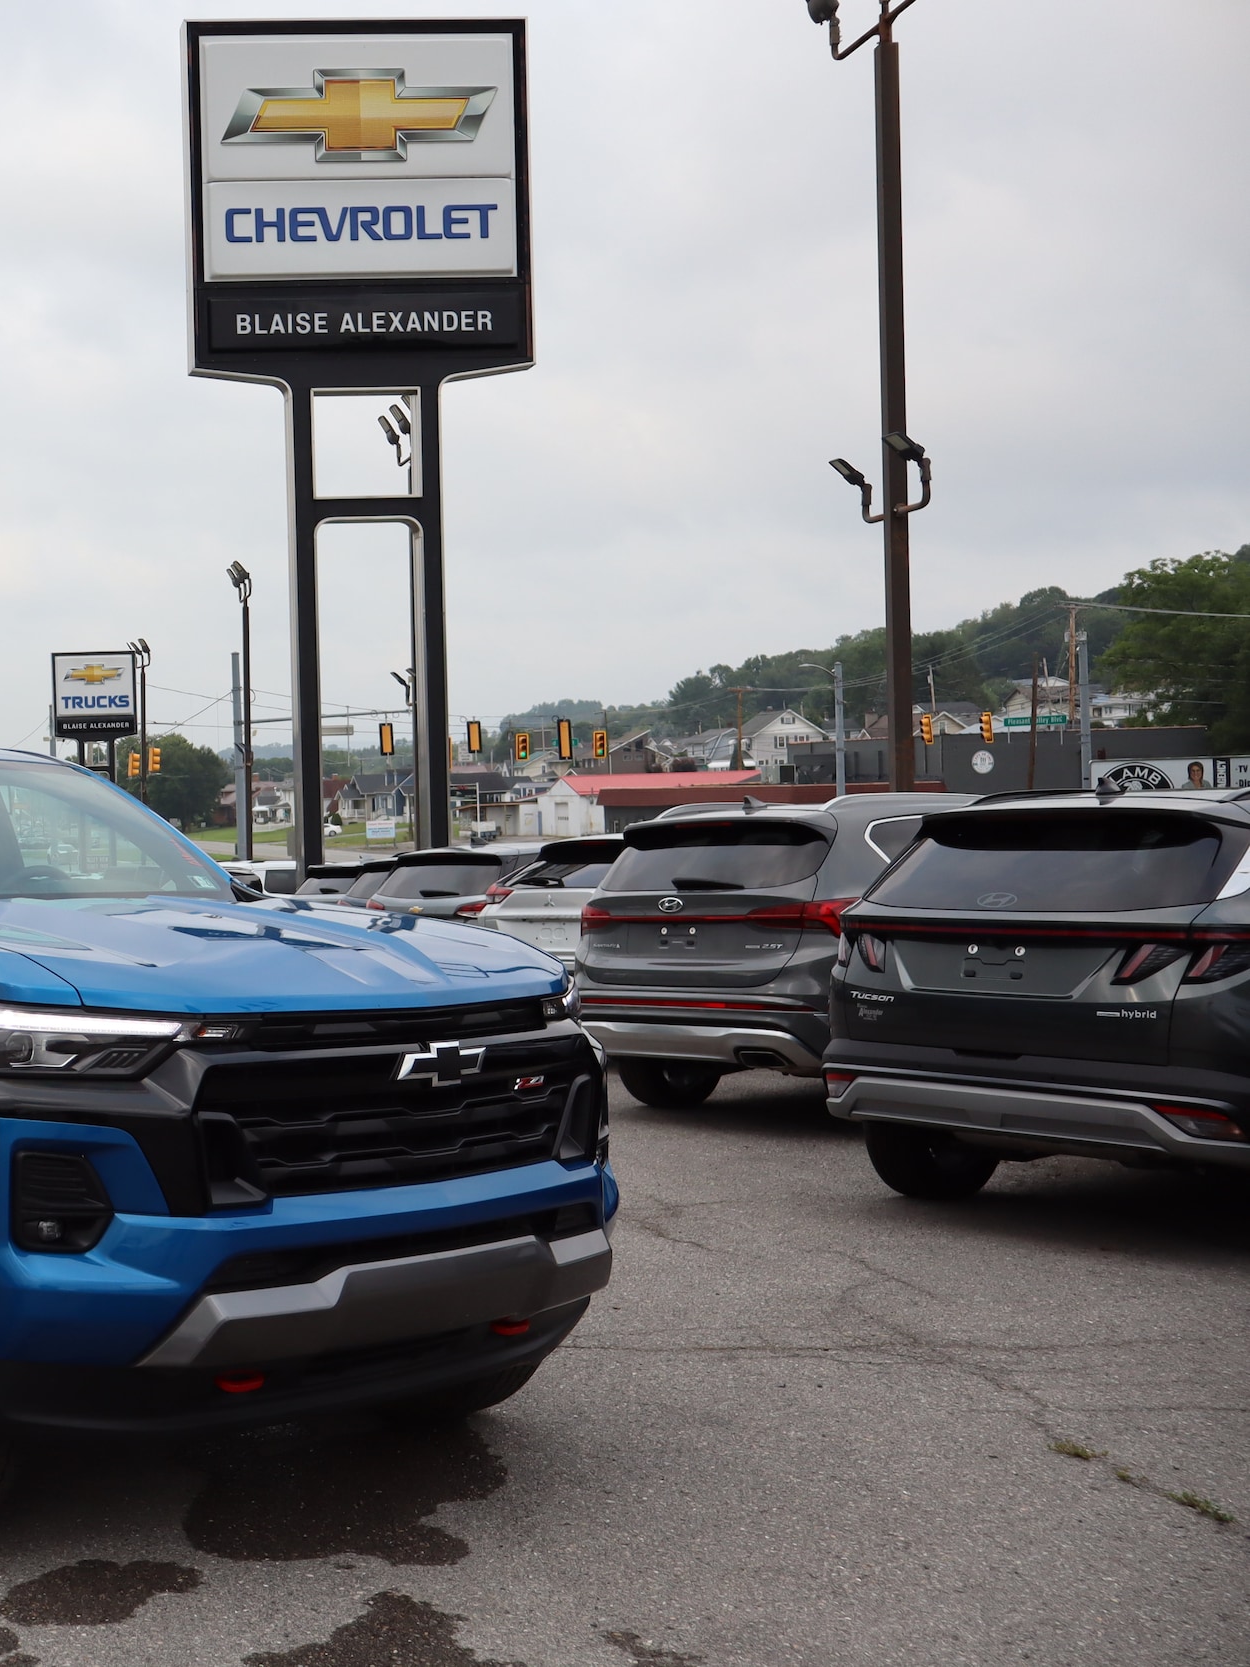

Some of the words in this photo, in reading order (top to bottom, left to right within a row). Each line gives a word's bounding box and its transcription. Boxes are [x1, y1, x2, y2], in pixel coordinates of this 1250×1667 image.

[225, 204, 498, 243] CHEVROLET
[236, 312, 329, 335] BLAISE
[340, 310, 493, 333] ALEXANDER
[61, 695, 130, 709] TRUCKS
[1109, 766, 1162, 785] LAMB
[1238, 765, 1248, 773] TV
[1121, 1009, 1157, 1019] hybrid
